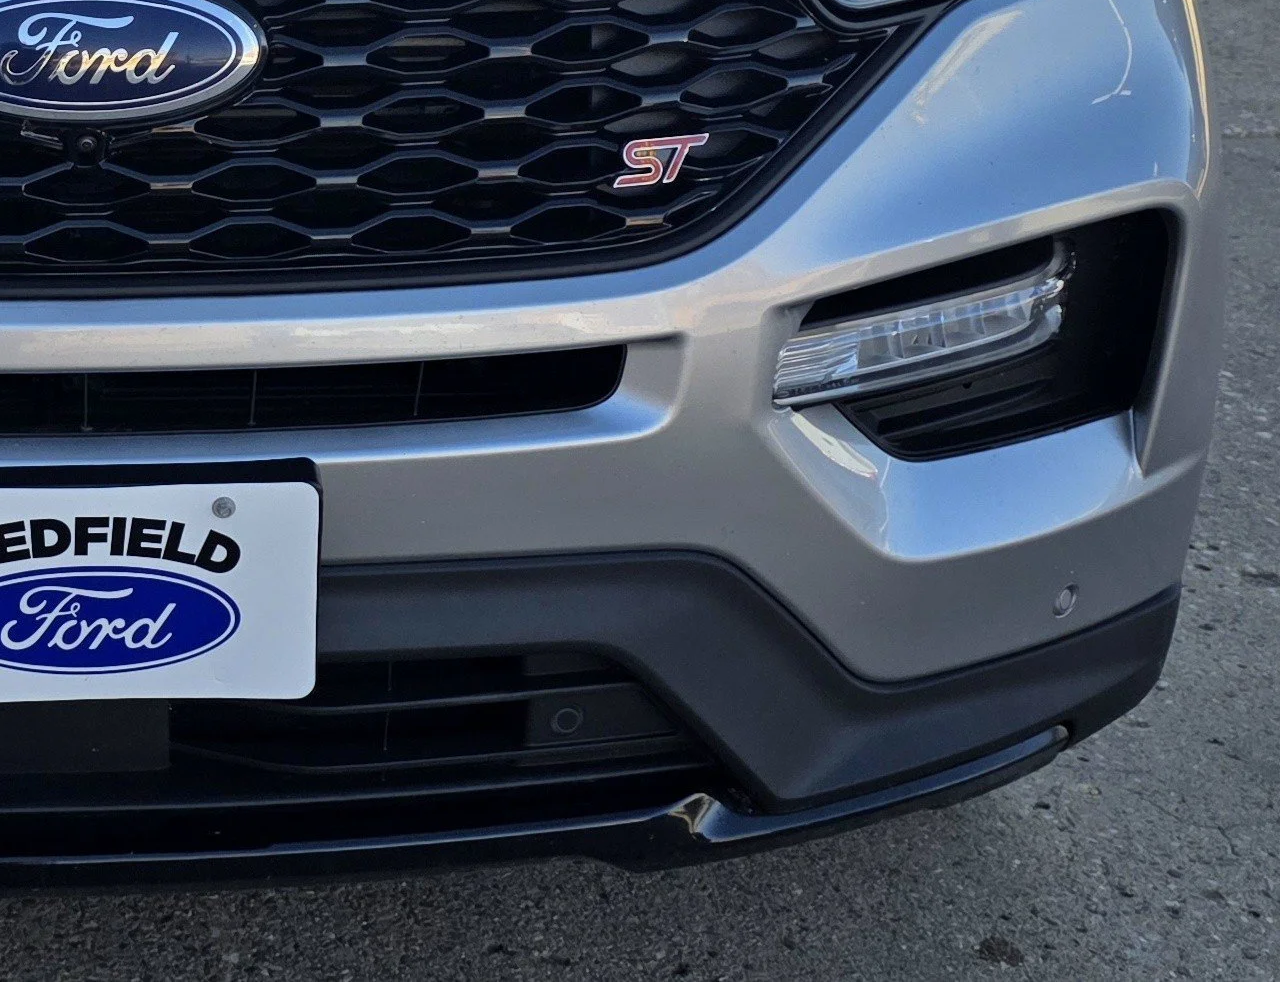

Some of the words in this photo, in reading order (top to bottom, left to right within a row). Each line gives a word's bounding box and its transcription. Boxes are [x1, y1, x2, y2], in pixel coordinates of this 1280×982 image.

[0, 12, 180, 86] Ford
[613, 132, 710, 188] ST
[0, 585, 177, 651] Ford
